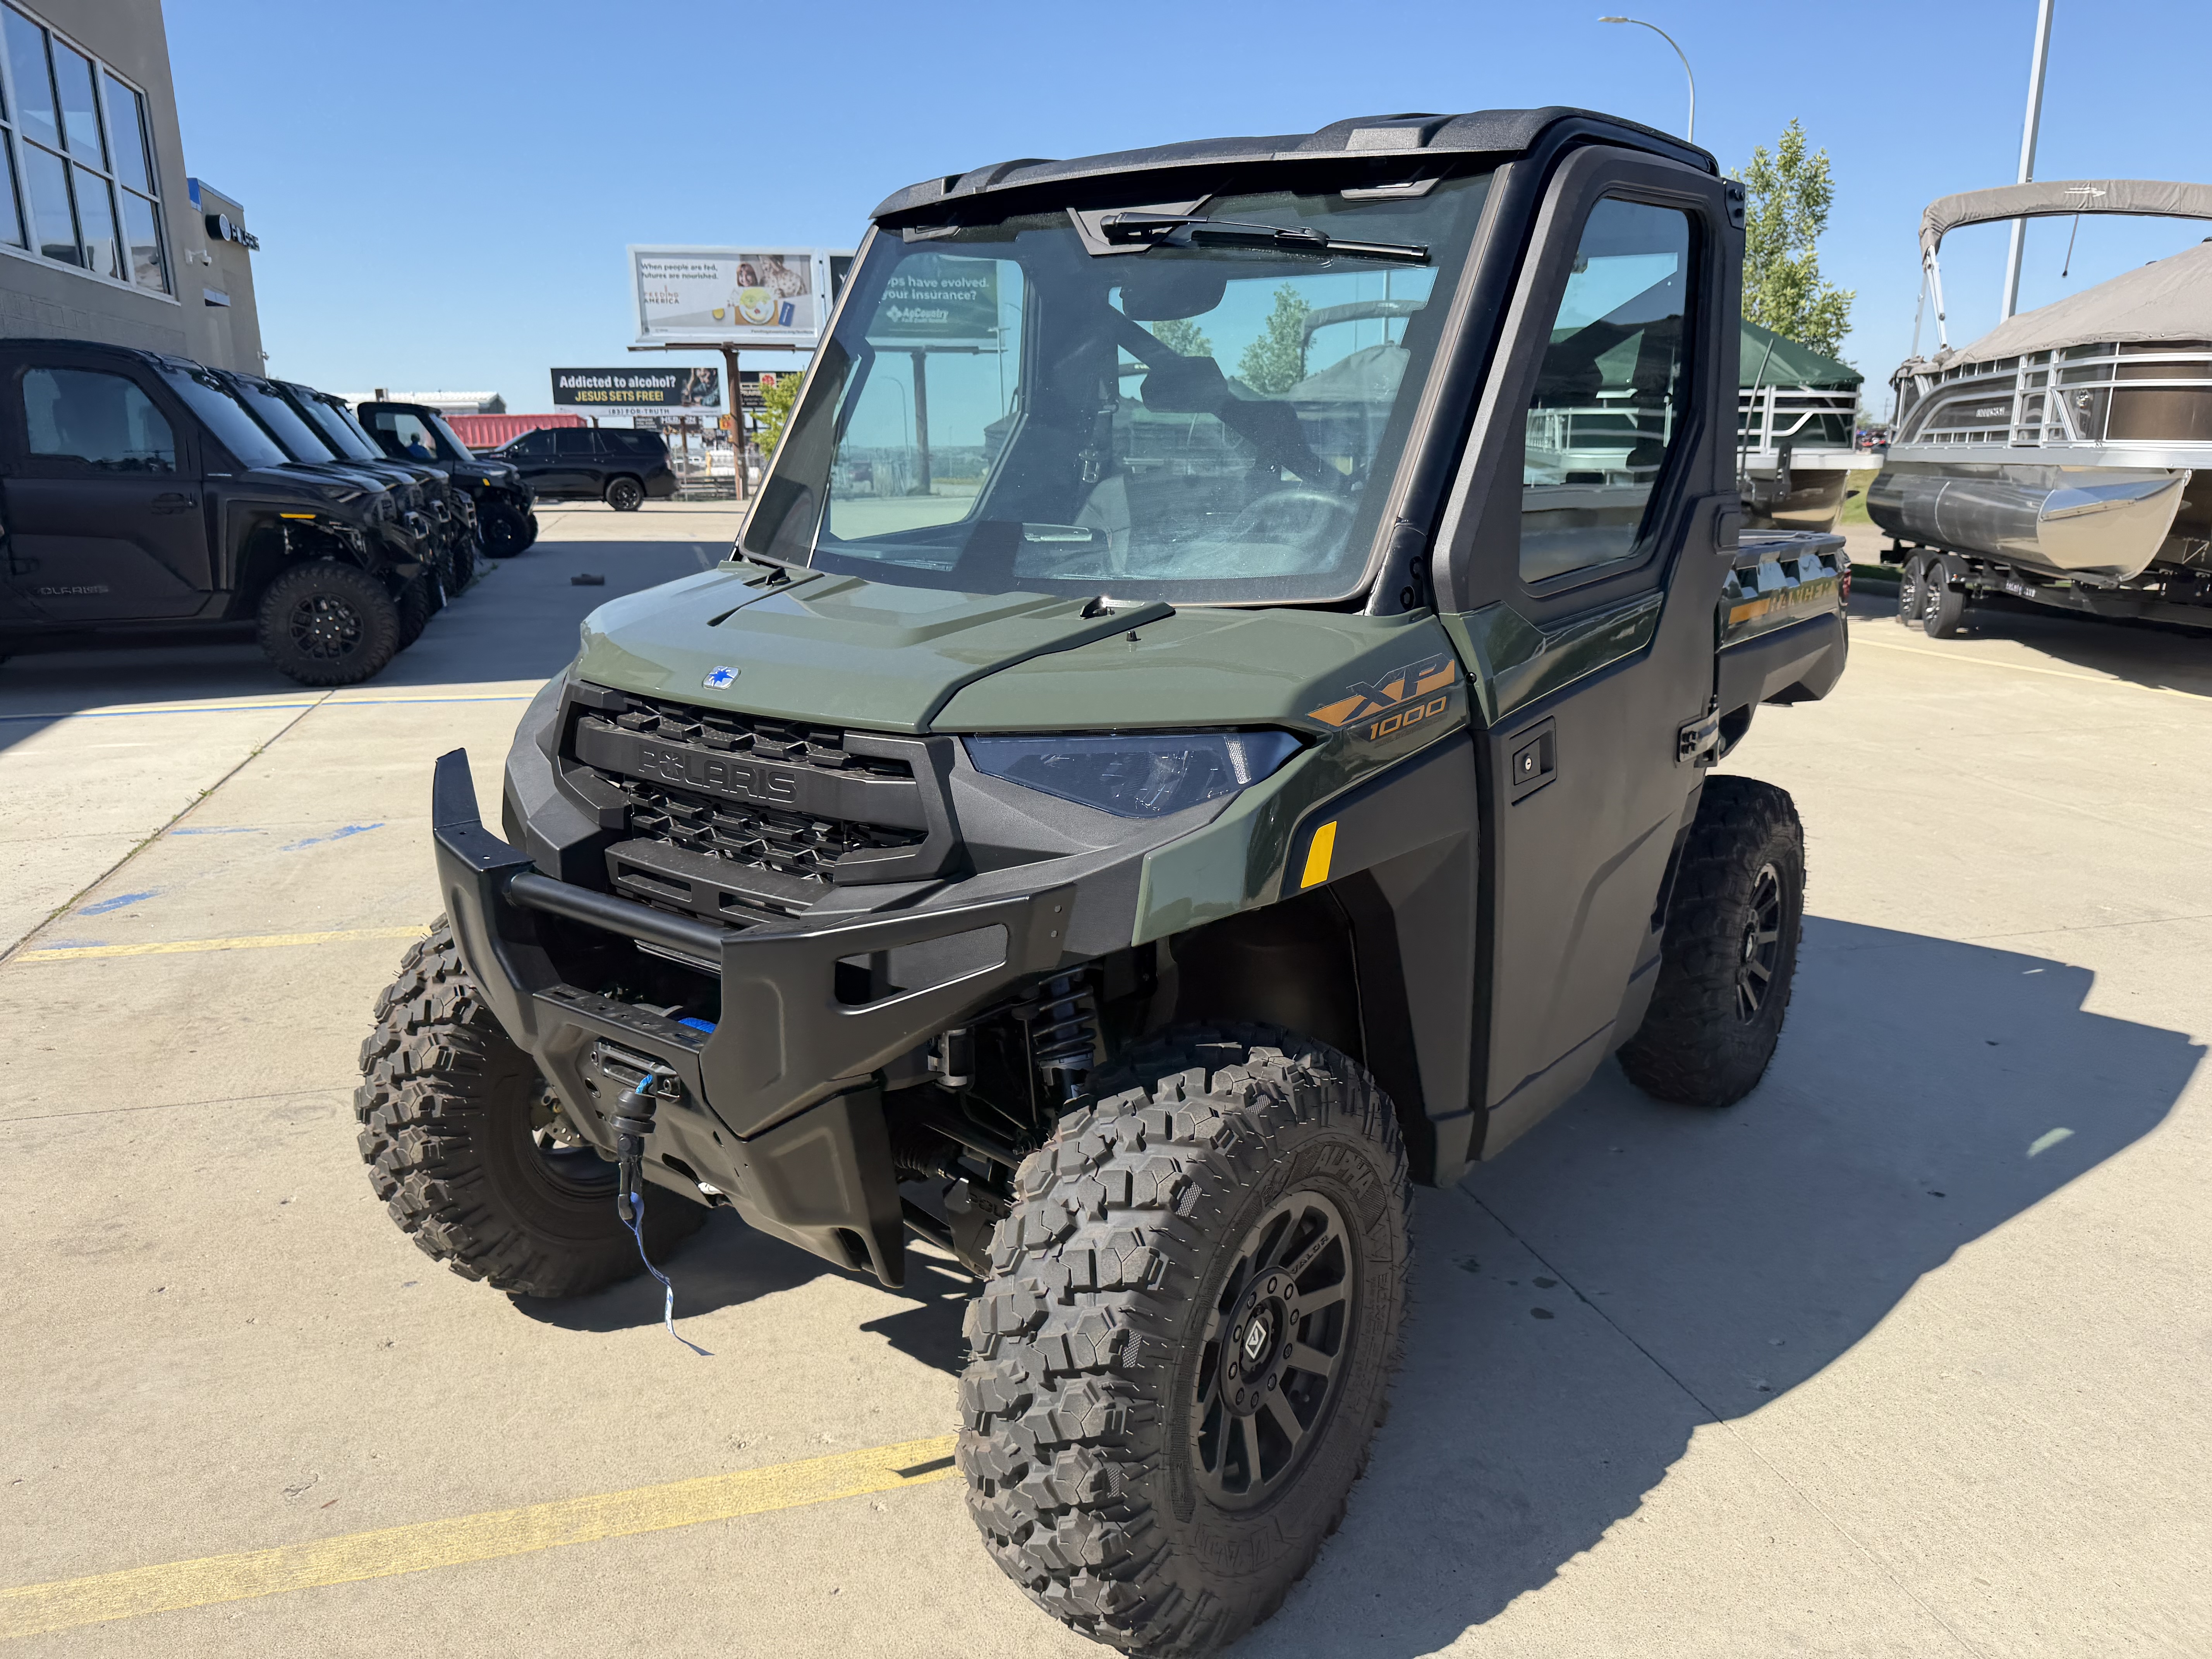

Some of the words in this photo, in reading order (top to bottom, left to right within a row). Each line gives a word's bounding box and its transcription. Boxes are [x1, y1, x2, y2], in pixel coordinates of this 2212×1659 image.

[704, 263, 718, 271] fed,
[908, 275, 938, 287] have
[941, 276, 989, 288] evolved.
[560, 376, 612, 388] Addicted
[613, 376, 627, 388] to
[628, 374, 676, 388] alcohol?
[575, 391, 608, 402] JESUS
[609, 391, 635, 402] SETS
[636, 390, 664, 401] FREE!
[1340, 653, 1451, 724] XP
[1370, 696, 1446, 740] 1000
[638, 744, 797, 804] POLARIS
[1308, 1144, 1376, 1200] ALPHA
[1289, 1235, 1330, 1274] VALOR
